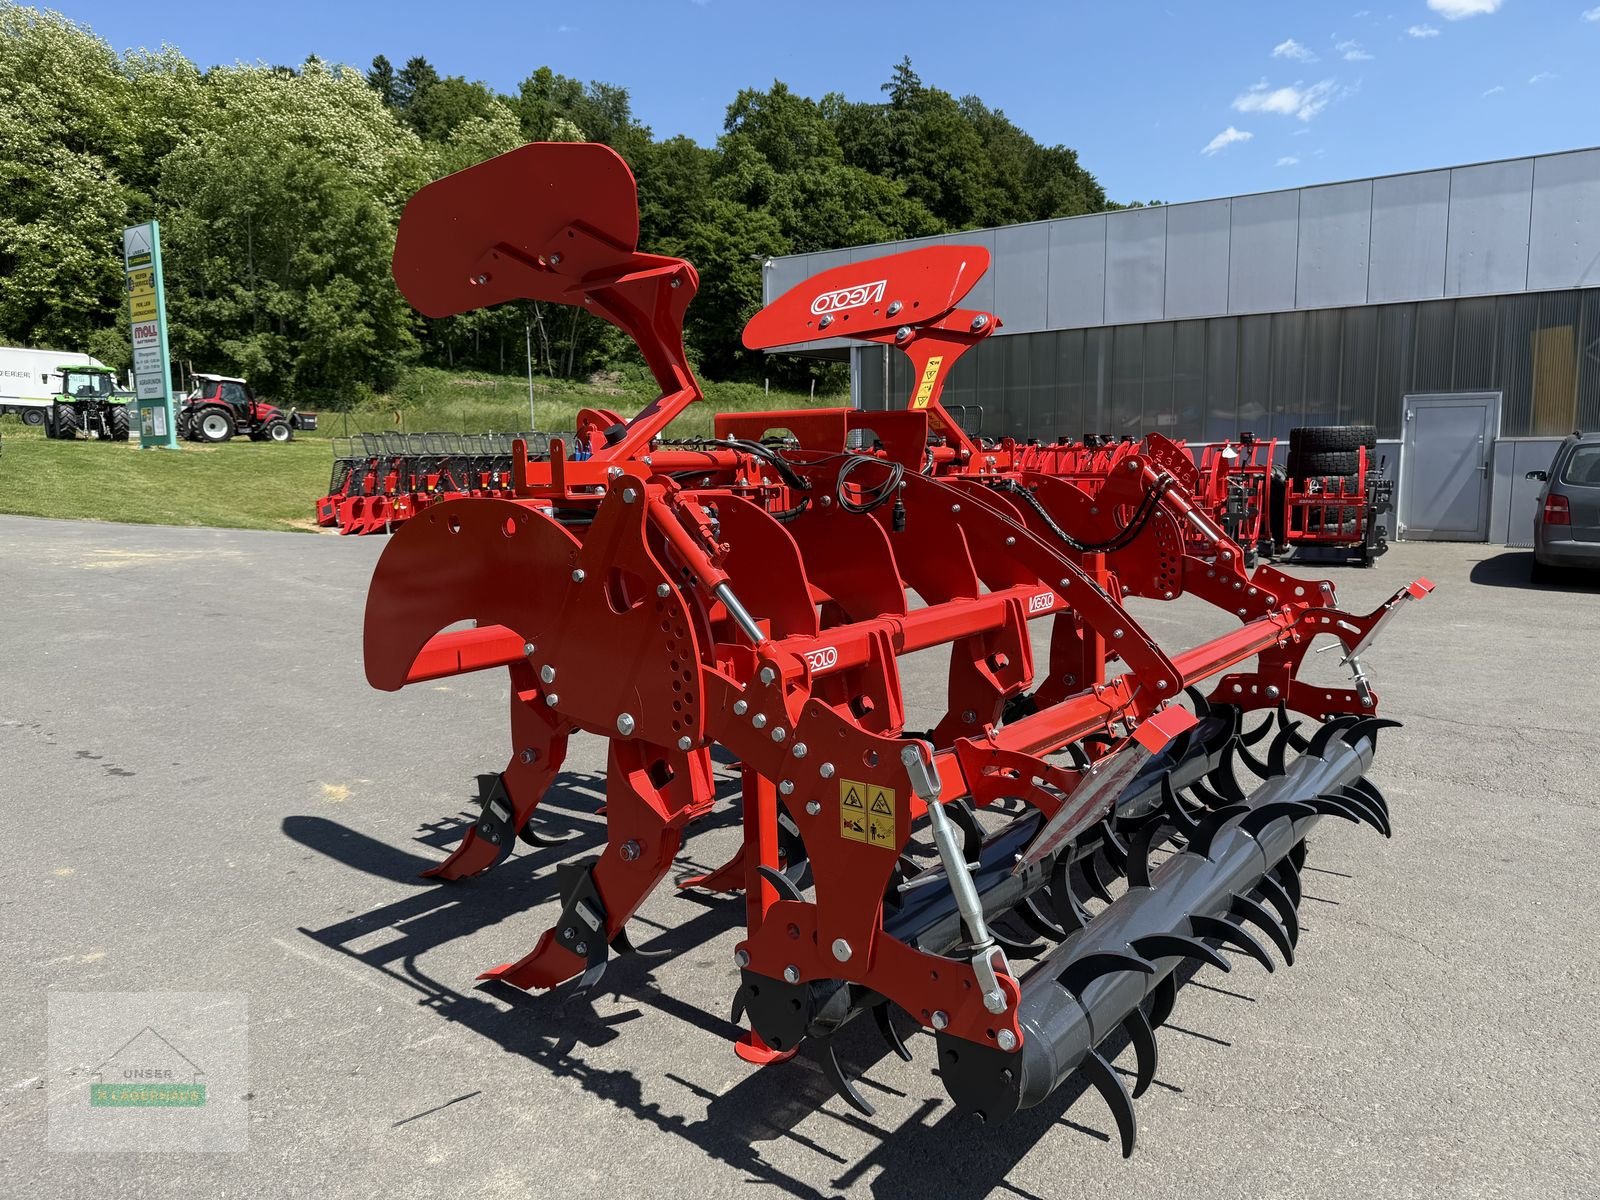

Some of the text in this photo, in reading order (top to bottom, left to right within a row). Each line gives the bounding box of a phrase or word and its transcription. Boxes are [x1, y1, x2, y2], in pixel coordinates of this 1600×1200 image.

[1164, 457, 1173, 466] 3
[1173, 466, 1182, 474] 4
[1181, 472, 1191, 481] 5
[807, 647, 838, 672] GOLO
